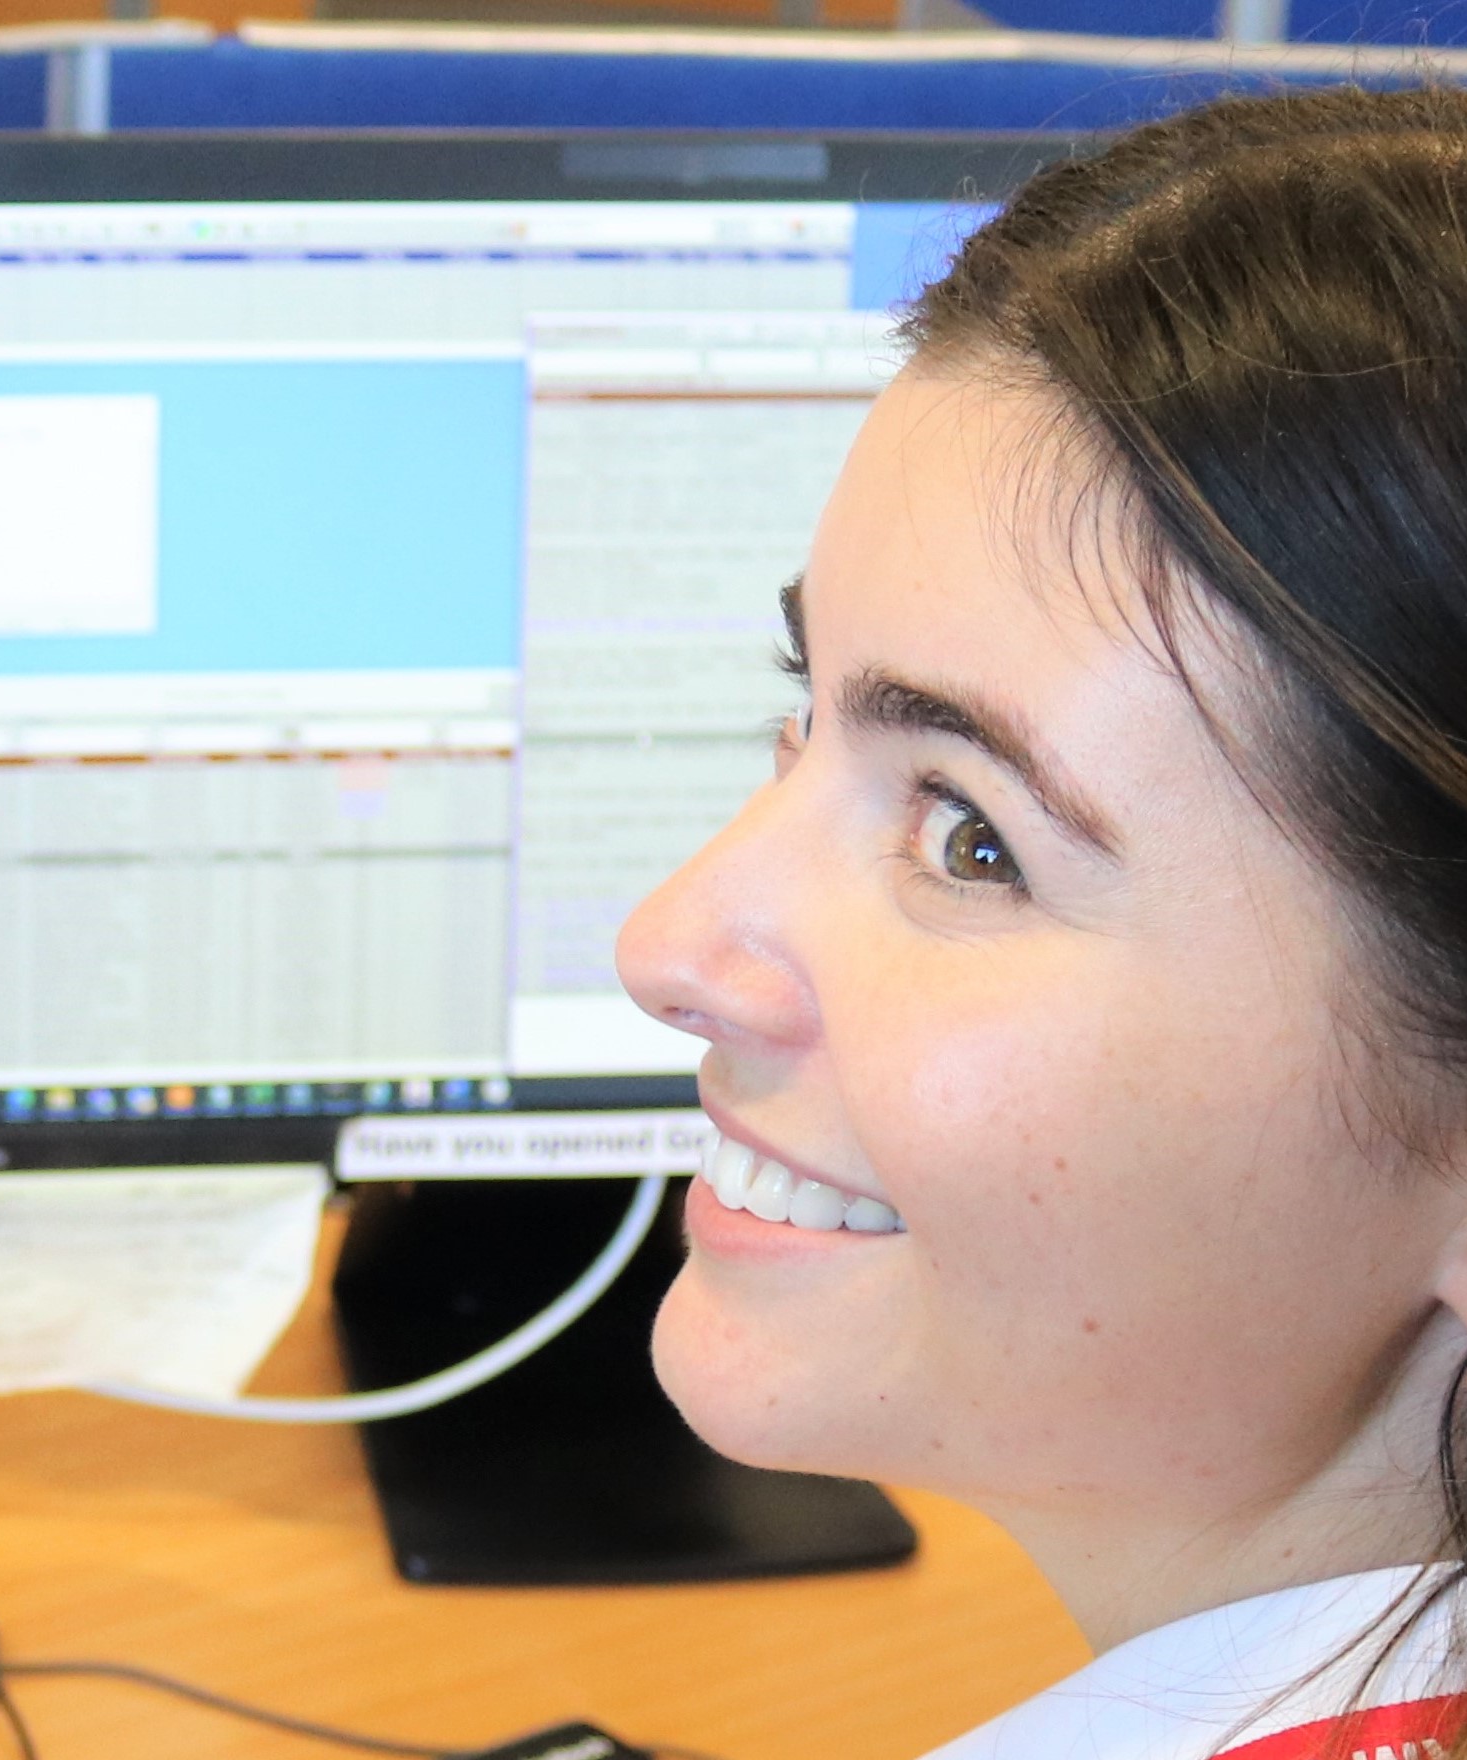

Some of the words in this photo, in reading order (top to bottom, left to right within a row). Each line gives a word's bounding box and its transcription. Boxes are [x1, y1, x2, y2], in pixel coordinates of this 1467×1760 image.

[355, 1129, 436, 1155] Have
[450, 1134, 513, 1160] you
[527, 1128, 653, 1160] opened
